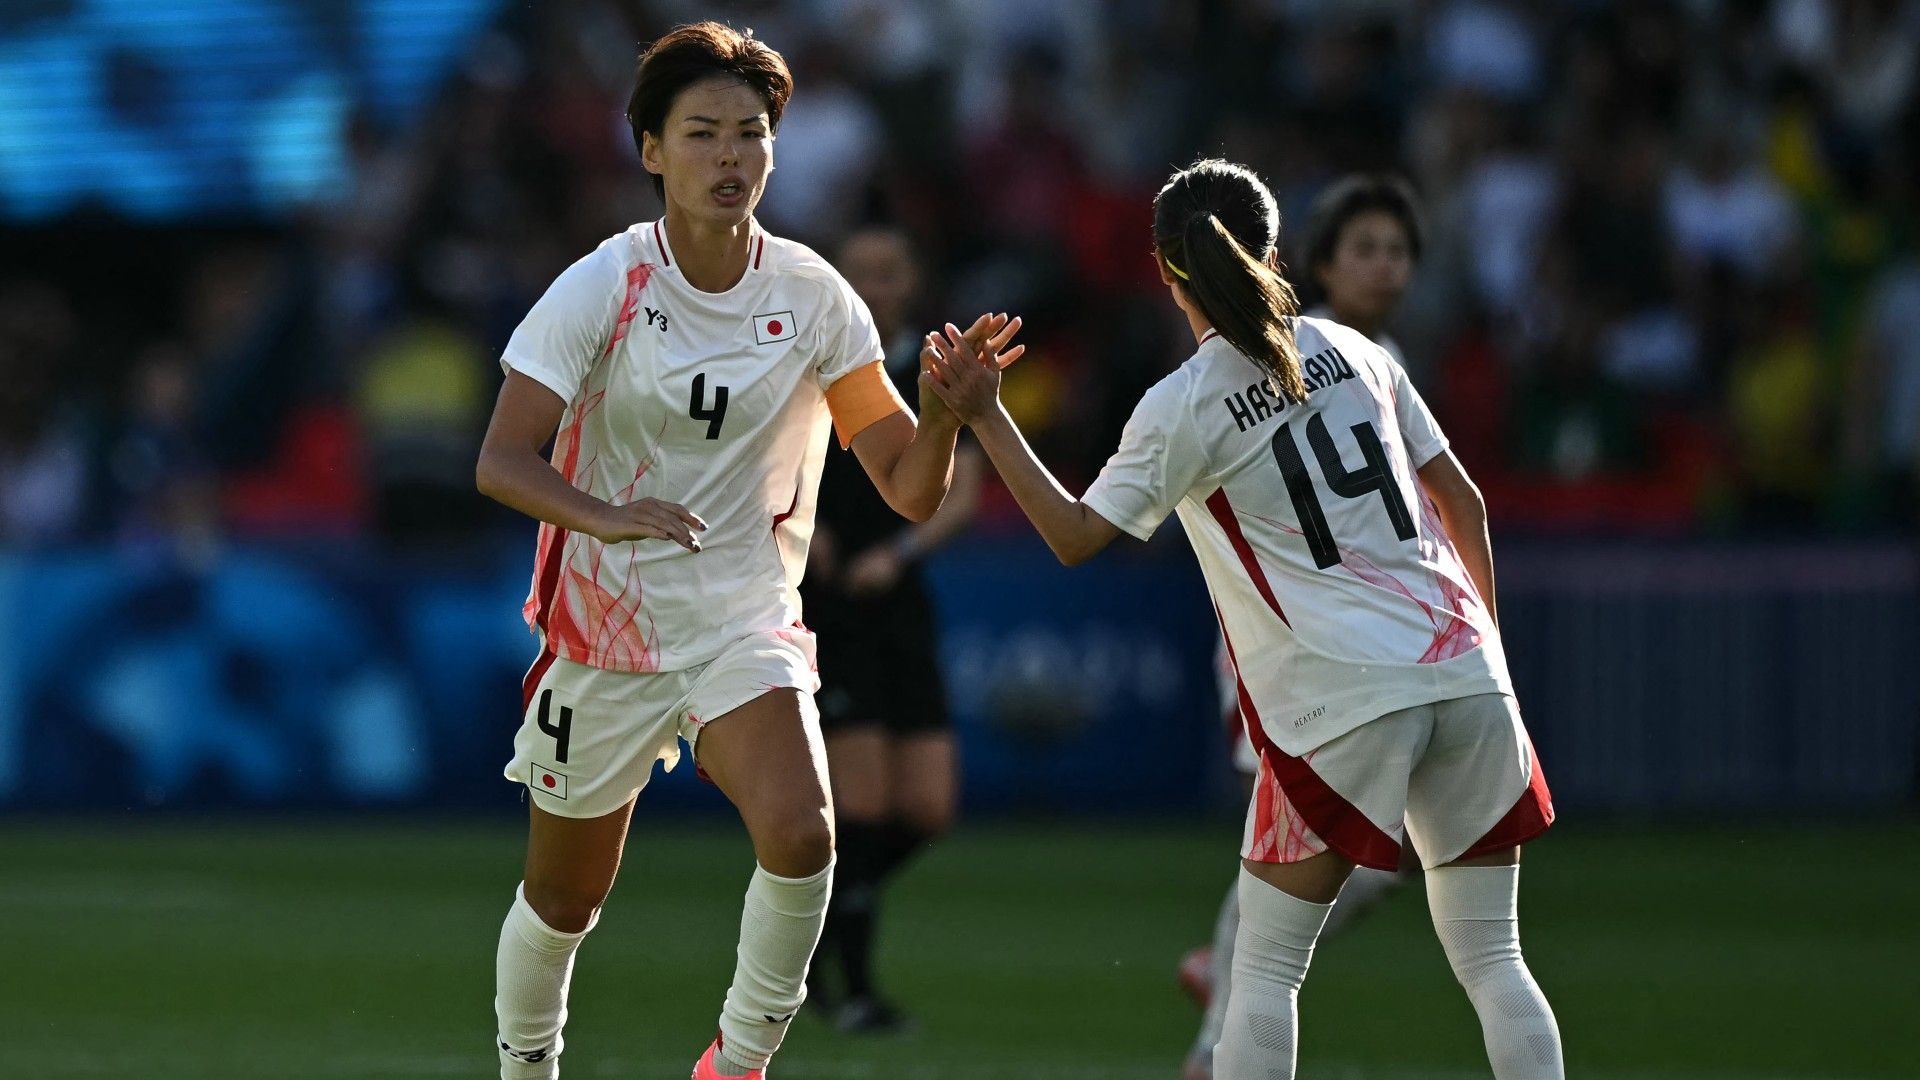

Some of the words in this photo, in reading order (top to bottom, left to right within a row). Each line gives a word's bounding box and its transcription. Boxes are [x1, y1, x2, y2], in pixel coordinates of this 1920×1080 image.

[644, 306, 668, 332] Y-3
[689, 372, 729, 440] 4
[1271, 411, 1418, 570] 14
[537, 688, 573, 764] 4
